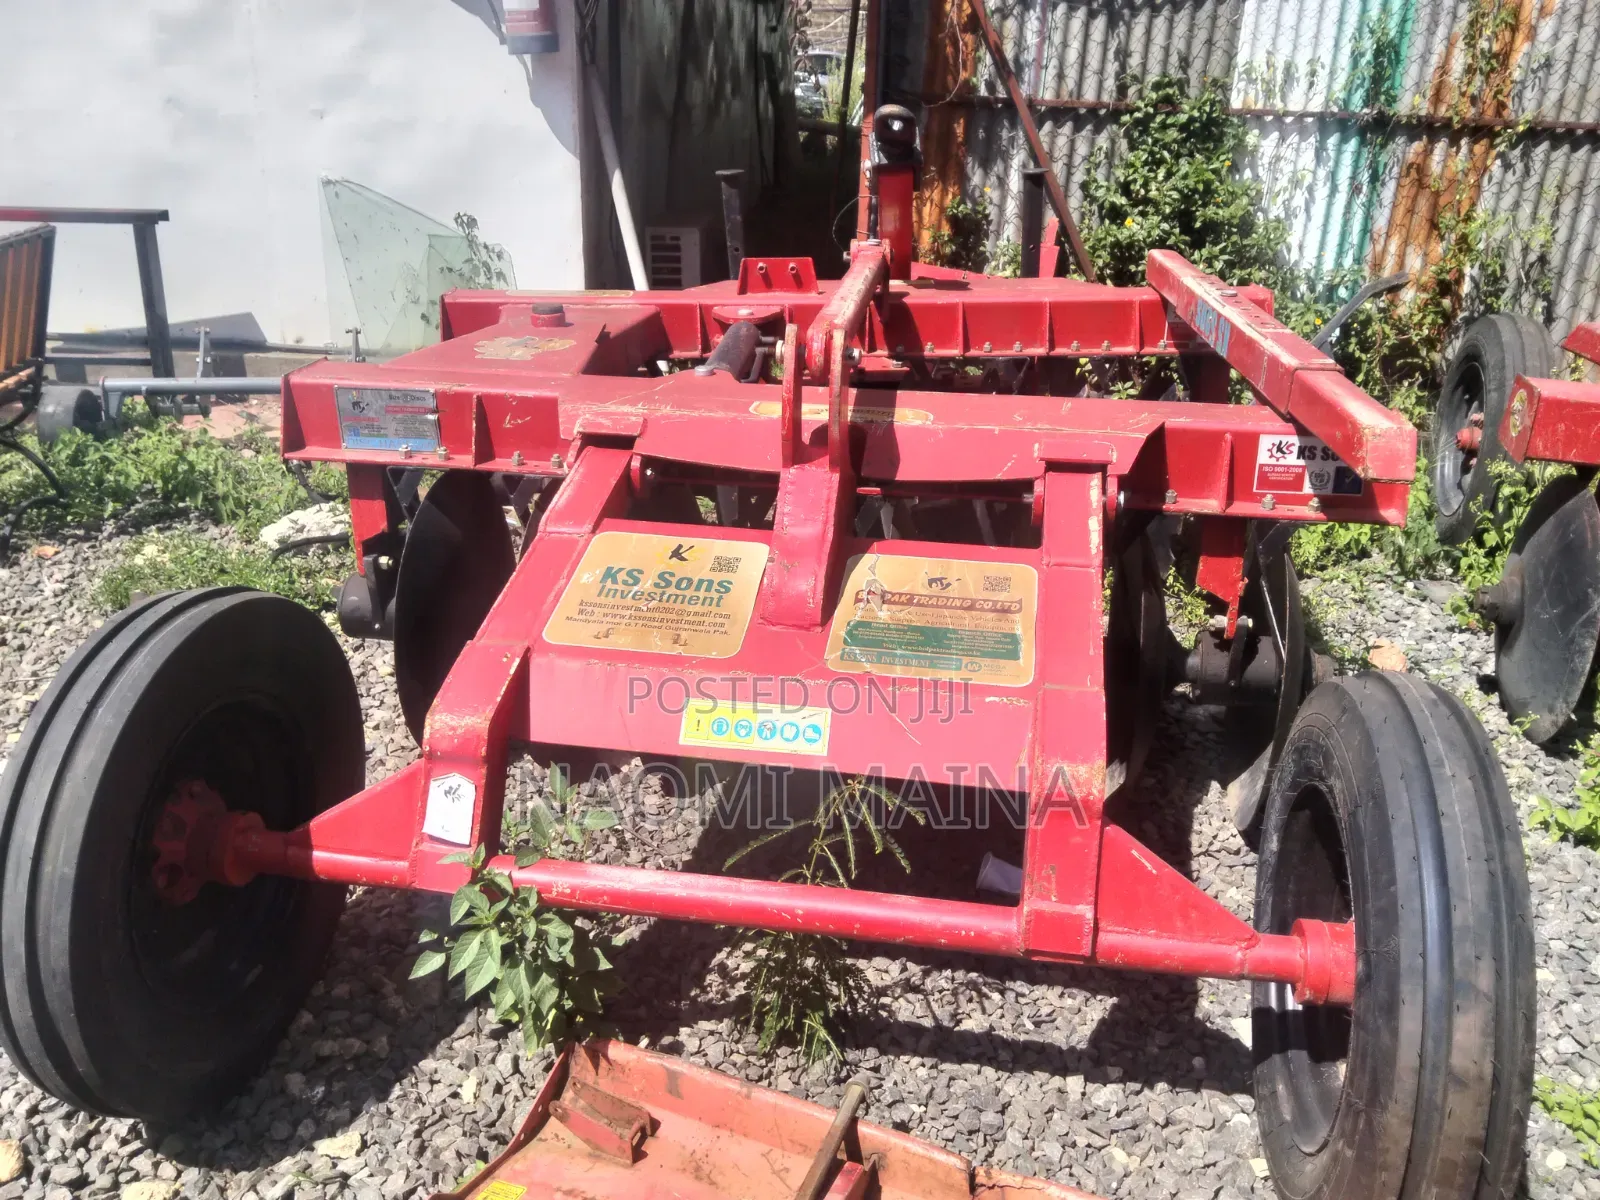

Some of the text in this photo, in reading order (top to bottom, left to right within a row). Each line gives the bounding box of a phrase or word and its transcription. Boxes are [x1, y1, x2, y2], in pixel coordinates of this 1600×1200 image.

[1297, 445, 1318, 460] KS
[599, 566, 733, 595] KS Sons
[597, 584, 724, 608] Investment
[913, 594, 973, 609] TRADING
[975, 599, 1021, 611] CO.LTD
[577, 608, 596, 617] Web
[881, 655, 931, 668] INVESTMENT
